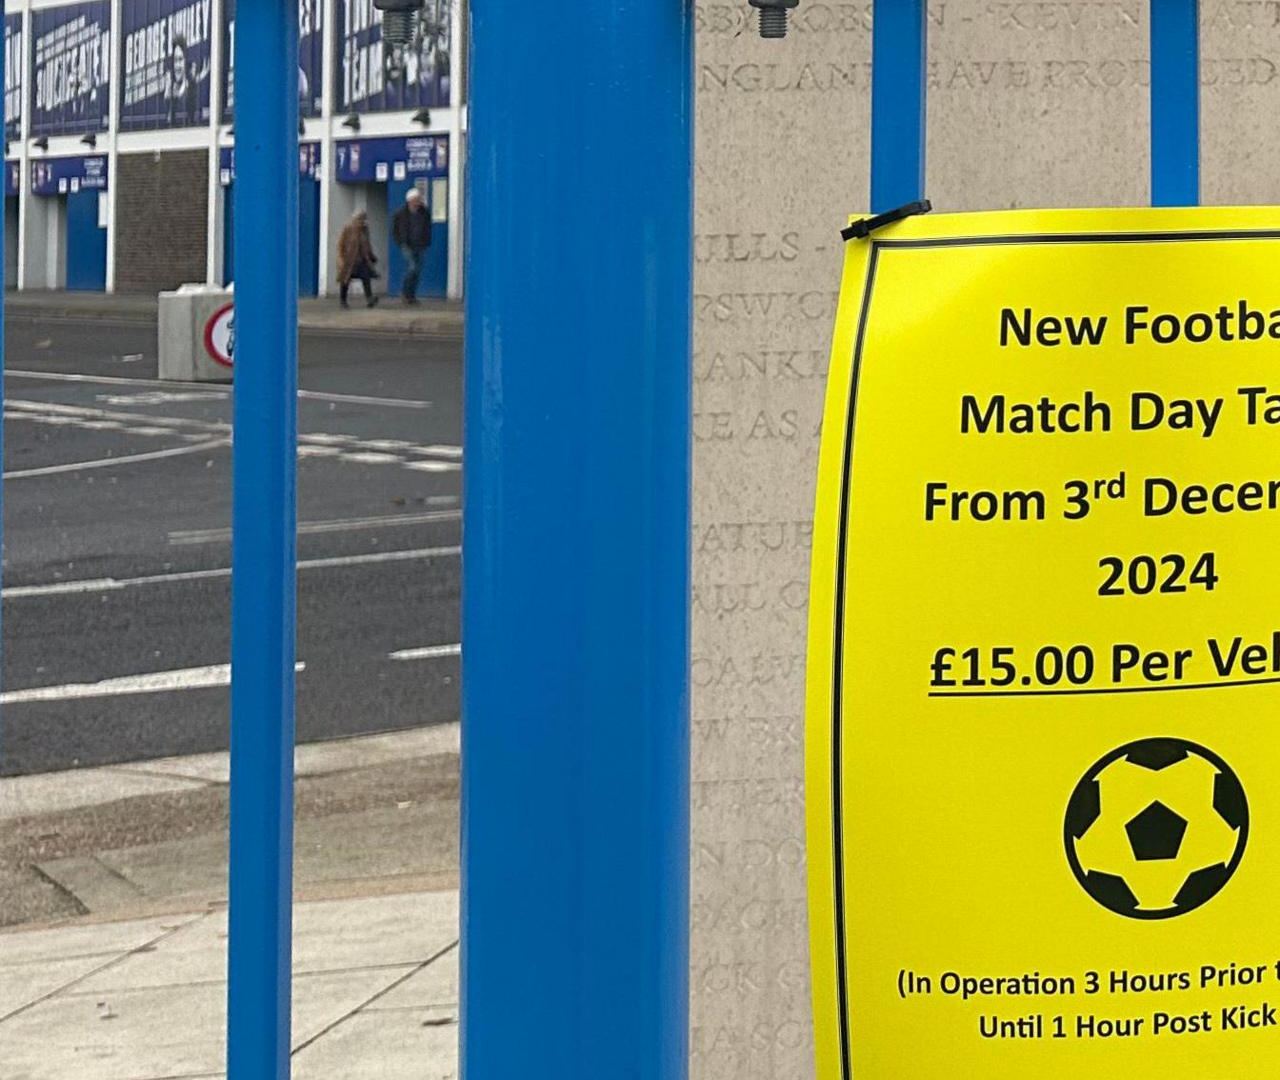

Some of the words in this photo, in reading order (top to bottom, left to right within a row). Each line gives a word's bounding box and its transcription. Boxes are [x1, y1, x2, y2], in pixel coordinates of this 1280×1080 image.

[999, 308, 1108, 348] New
[960, 390, 1112, 434] Match
[1130, 392, 1225, 438] Day
[925, 482, 1046, 522] From
[1063, 470, 1127, 520] 3rd
[1097, 552, 1220, 597] 2024
[929, 646, 1095, 689] £15.00
[1111, 644, 1194, 683] Per
[898, 969, 932, 999] (In
[940, 972, 1075, 1001] Operation
[1084, 971, 1101, 995] 3
[1110, 970, 1192, 994] Hours
[1200, 961, 1268, 990] Prior
[979, 1013, 1043, 1039] Until
[1052, 1014, 1067, 1039] 1
[1076, 1014, 1144, 1038] Hour
[1153, 1011, 1213, 1036] Post
[1222, 1002, 1278, 1031] Kick
